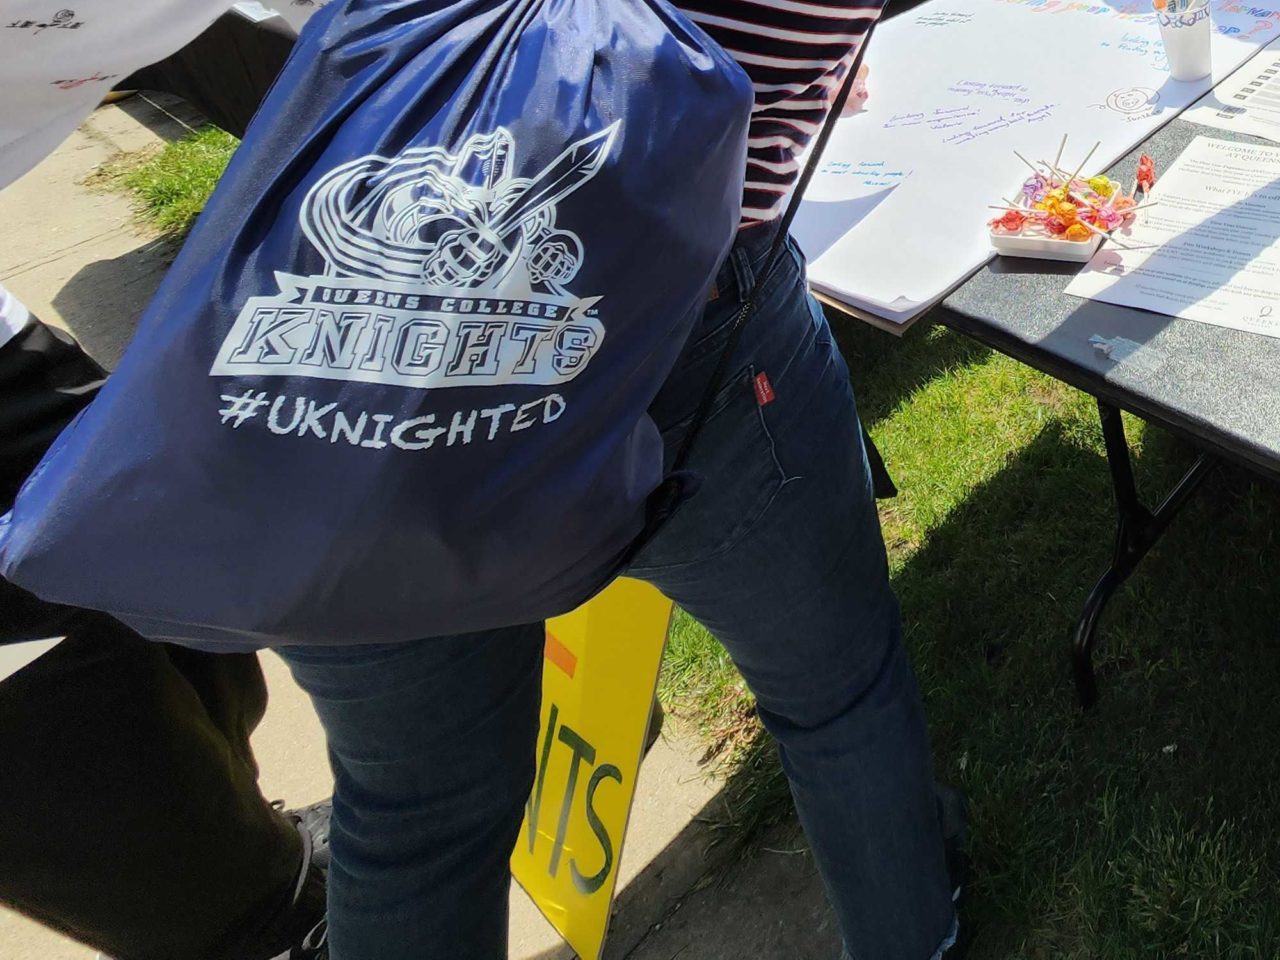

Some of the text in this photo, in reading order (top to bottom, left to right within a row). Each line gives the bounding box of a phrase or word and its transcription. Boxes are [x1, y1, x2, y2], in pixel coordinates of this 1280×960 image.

[1207, 142, 1261, 157] WELCOME
[1264, 149, 1275, 158] TO
[322, 288, 558, 318] QUEENS COLLEGE
[227, 306, 599, 378] KNIGHTS
[219, 388, 567, 450] #UKNIGHTED
